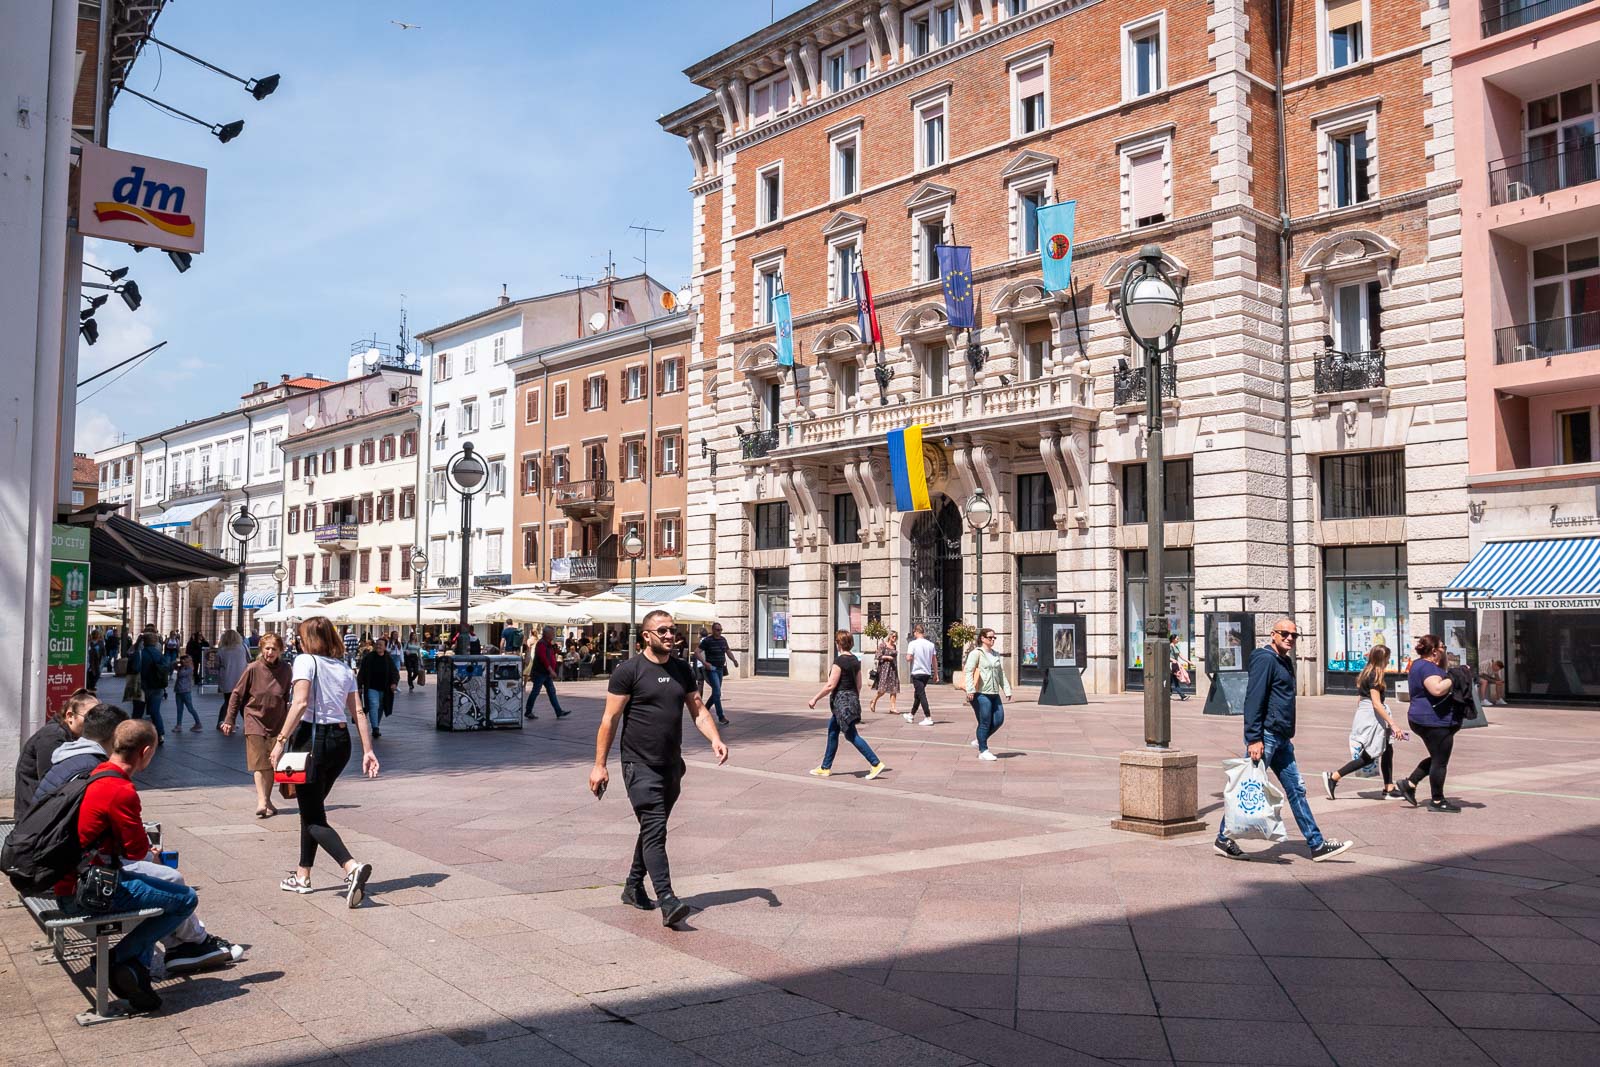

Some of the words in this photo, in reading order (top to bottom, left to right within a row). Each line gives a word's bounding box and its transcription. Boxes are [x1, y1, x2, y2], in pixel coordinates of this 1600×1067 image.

[113, 166, 186, 213] dm
[1471, 599, 1528, 609] TURISTIČKI
[49, 637, 74, 652] Grill
